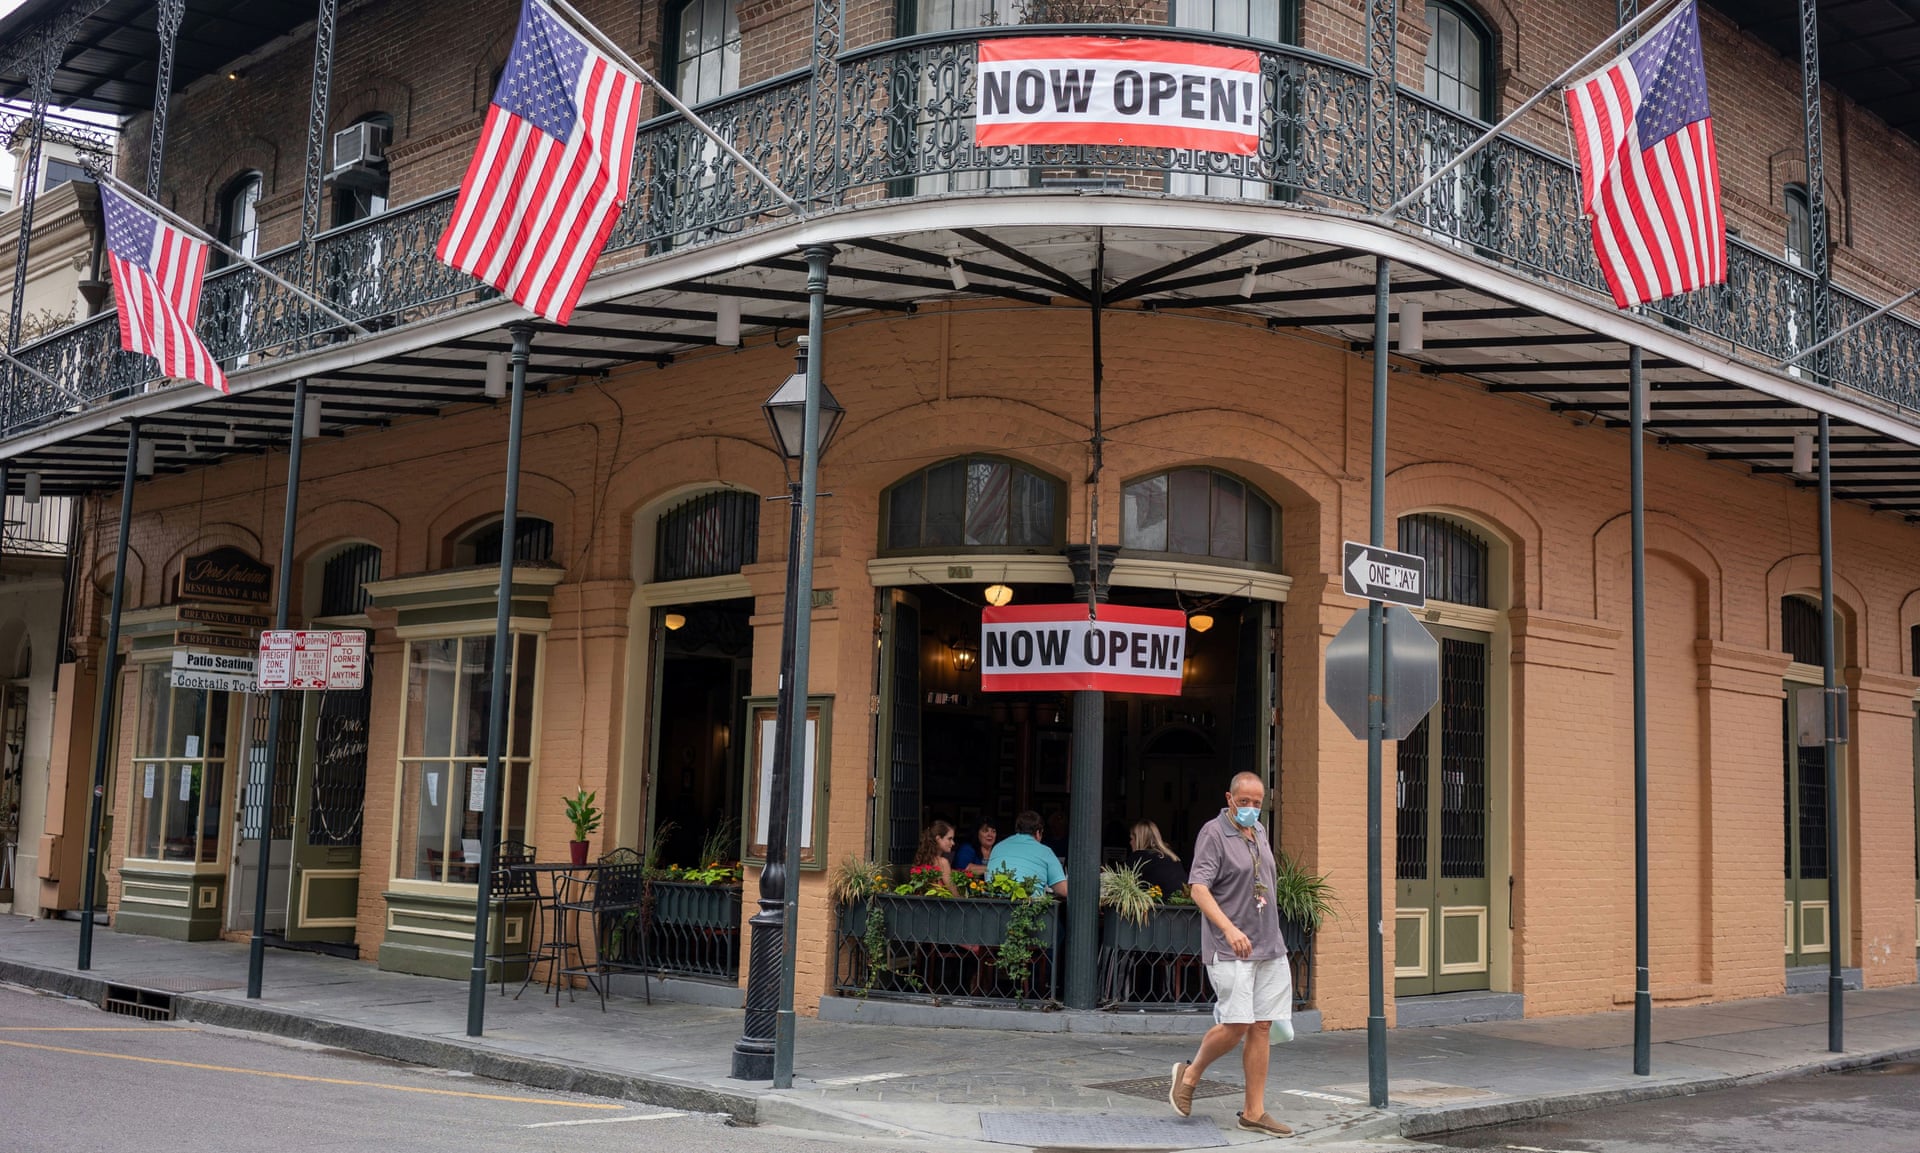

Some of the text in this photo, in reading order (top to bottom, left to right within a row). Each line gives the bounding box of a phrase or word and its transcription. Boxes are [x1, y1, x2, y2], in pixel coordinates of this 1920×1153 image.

[982, 68, 1253, 126] NOW OPEN!
[1368, 563, 1391, 586] ONE
[185, 583, 268, 600] RESTAURANT & BAR
[184, 609, 265, 626] BREAKFAST ALL DAY
[182, 634, 259, 649] CREOLE CUISIN
[271, 637, 293, 645] PARKING
[295, 636, 305, 648] NO
[331, 634, 363, 645] NO STOPPING
[262, 651, 289, 660] FREIGHT
[985, 628, 1181, 671] NOW OPEN!
[187, 654, 253, 672] Patio Seating
[266, 661, 283, 669] ZONE
[333, 655, 360, 663] CORNER
[331, 671, 361, 679] ANYTIME
[177, 674, 264, 693] Cocktails To-G
